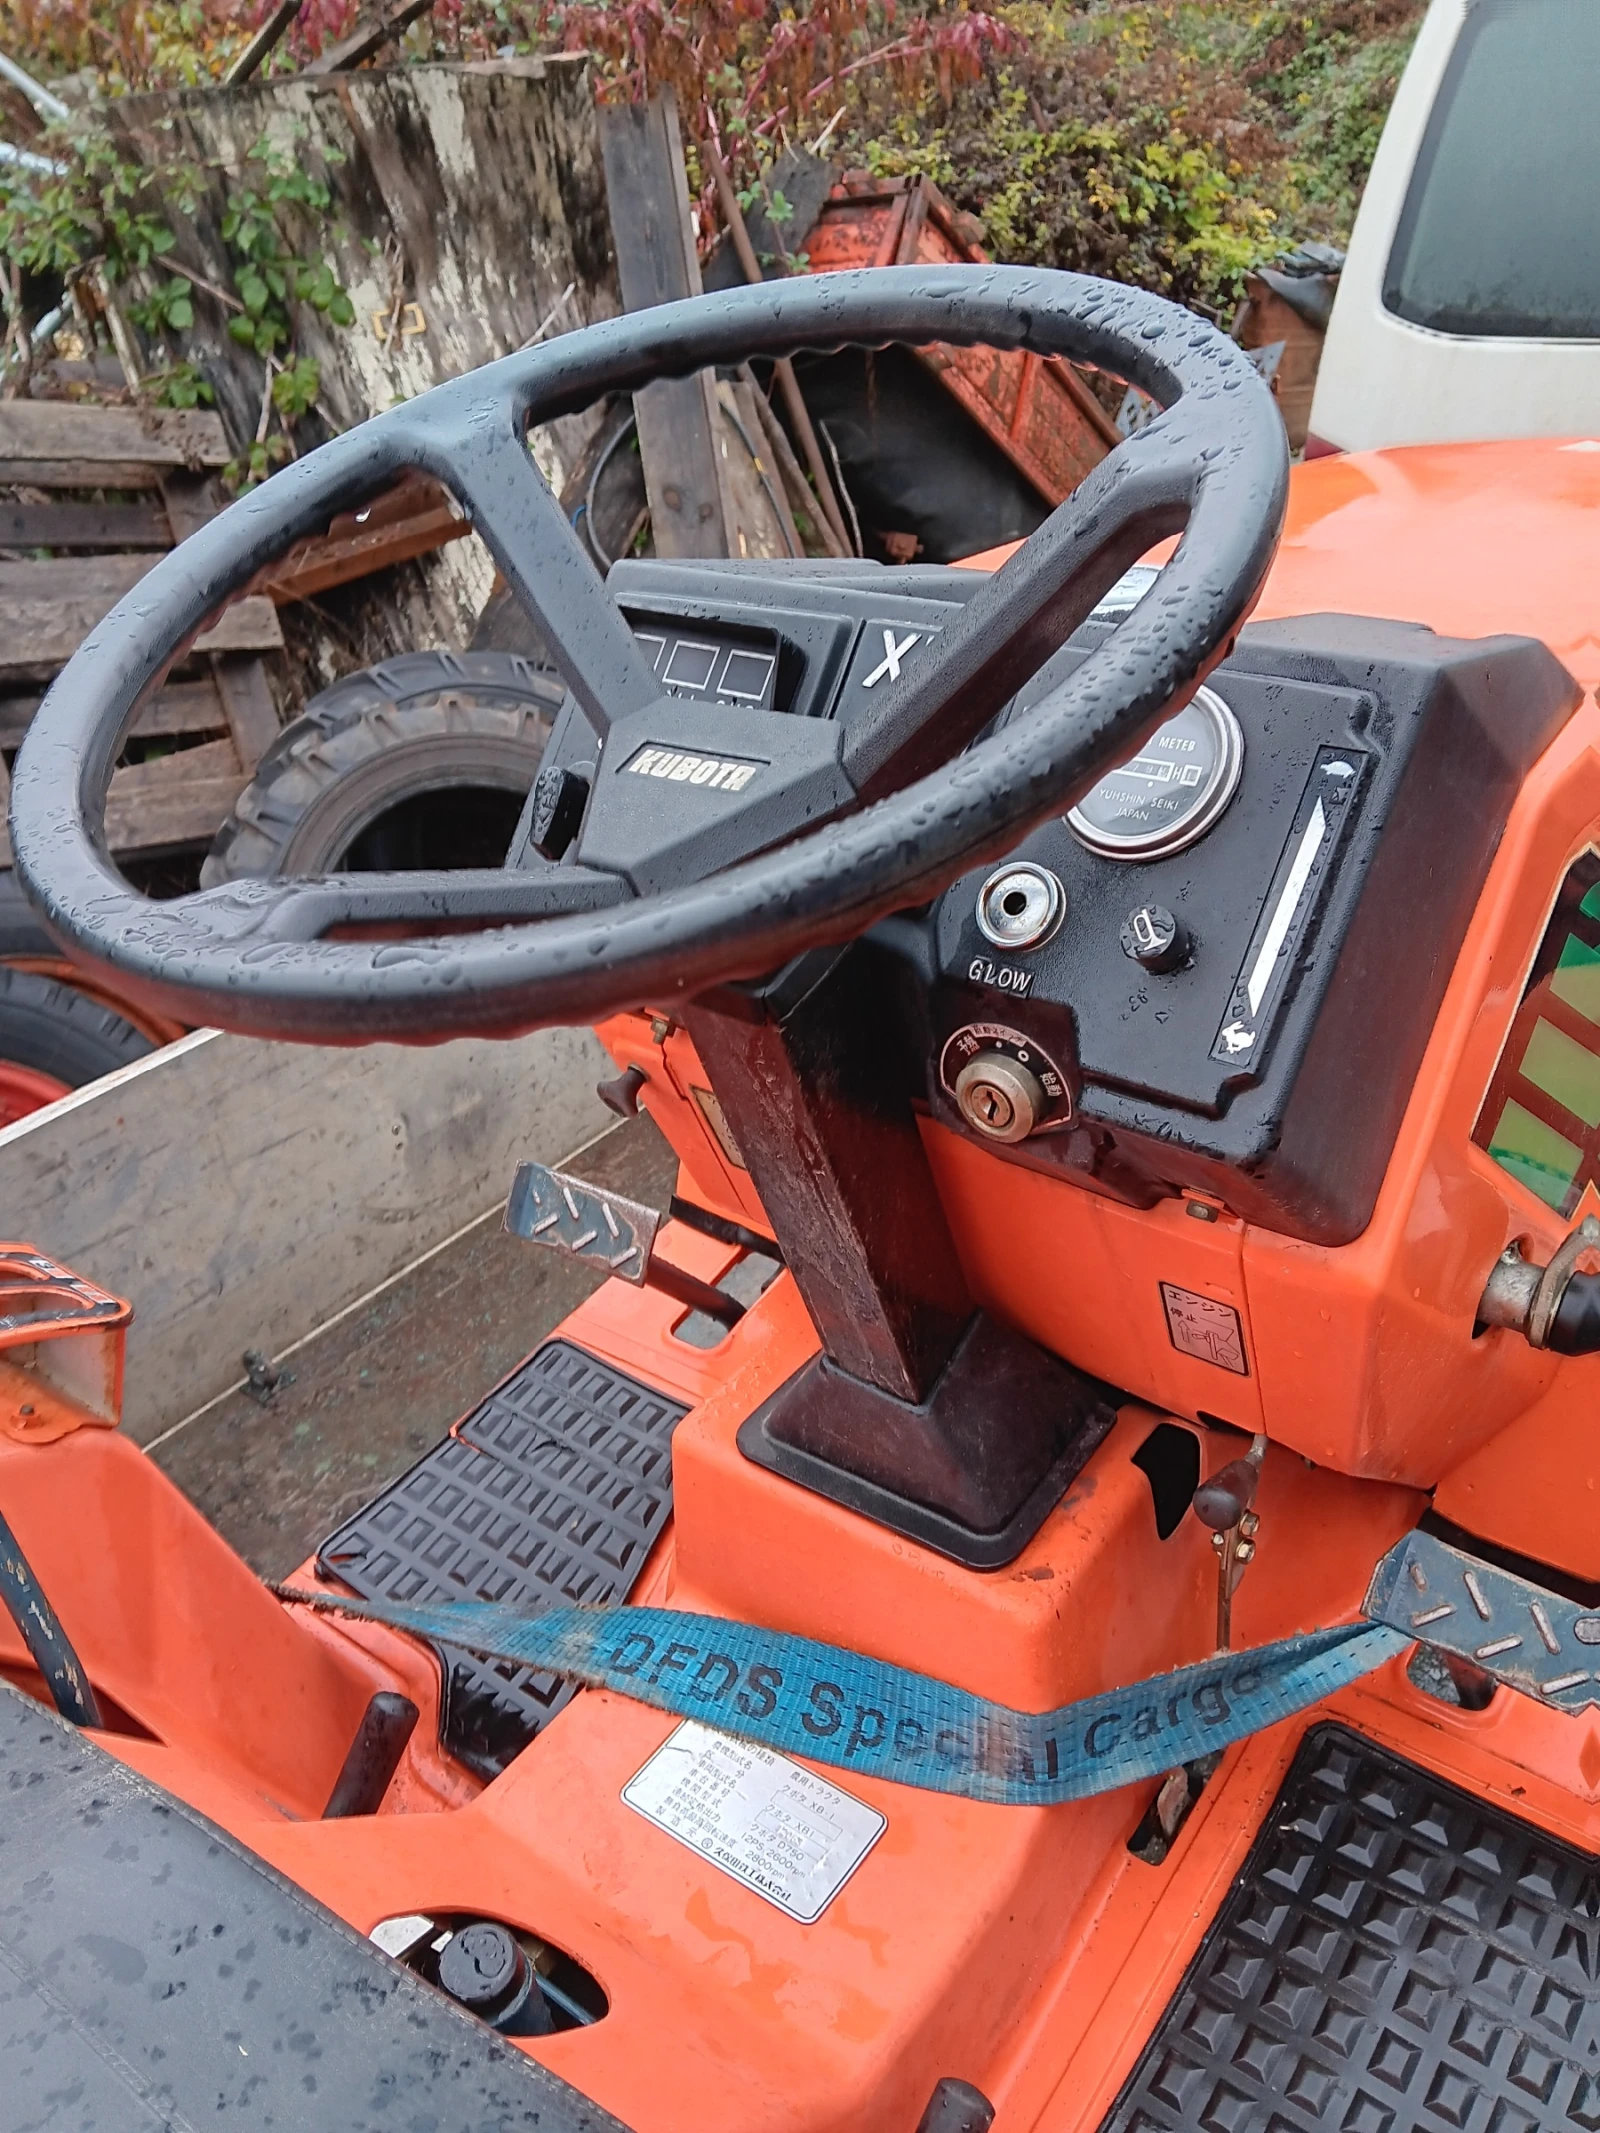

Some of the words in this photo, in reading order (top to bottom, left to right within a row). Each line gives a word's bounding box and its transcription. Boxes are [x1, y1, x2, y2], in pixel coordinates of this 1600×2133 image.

[862, 630, 934, 688] X
[1158, 736, 1196, 752] METER
[628, 749, 757, 792] KUBOTA
[1100, 788, 1146, 805] YUHSHIN
[1150, 797, 1179, 811] SEIKI
[1115, 806, 1150, 821] JAPAN
[968, 958, 1031, 993] GLOW
[1168, 1289, 1232, 1317] エンジン
[1170, 1306, 1198, 1324] 停止
[611, 1632, 784, 1721] DFDS
[1084, 1663, 1263, 1759] Cargo
[744, 1849, 787, 1881] 2800rpm
[776, 1840, 804, 1862] D750
